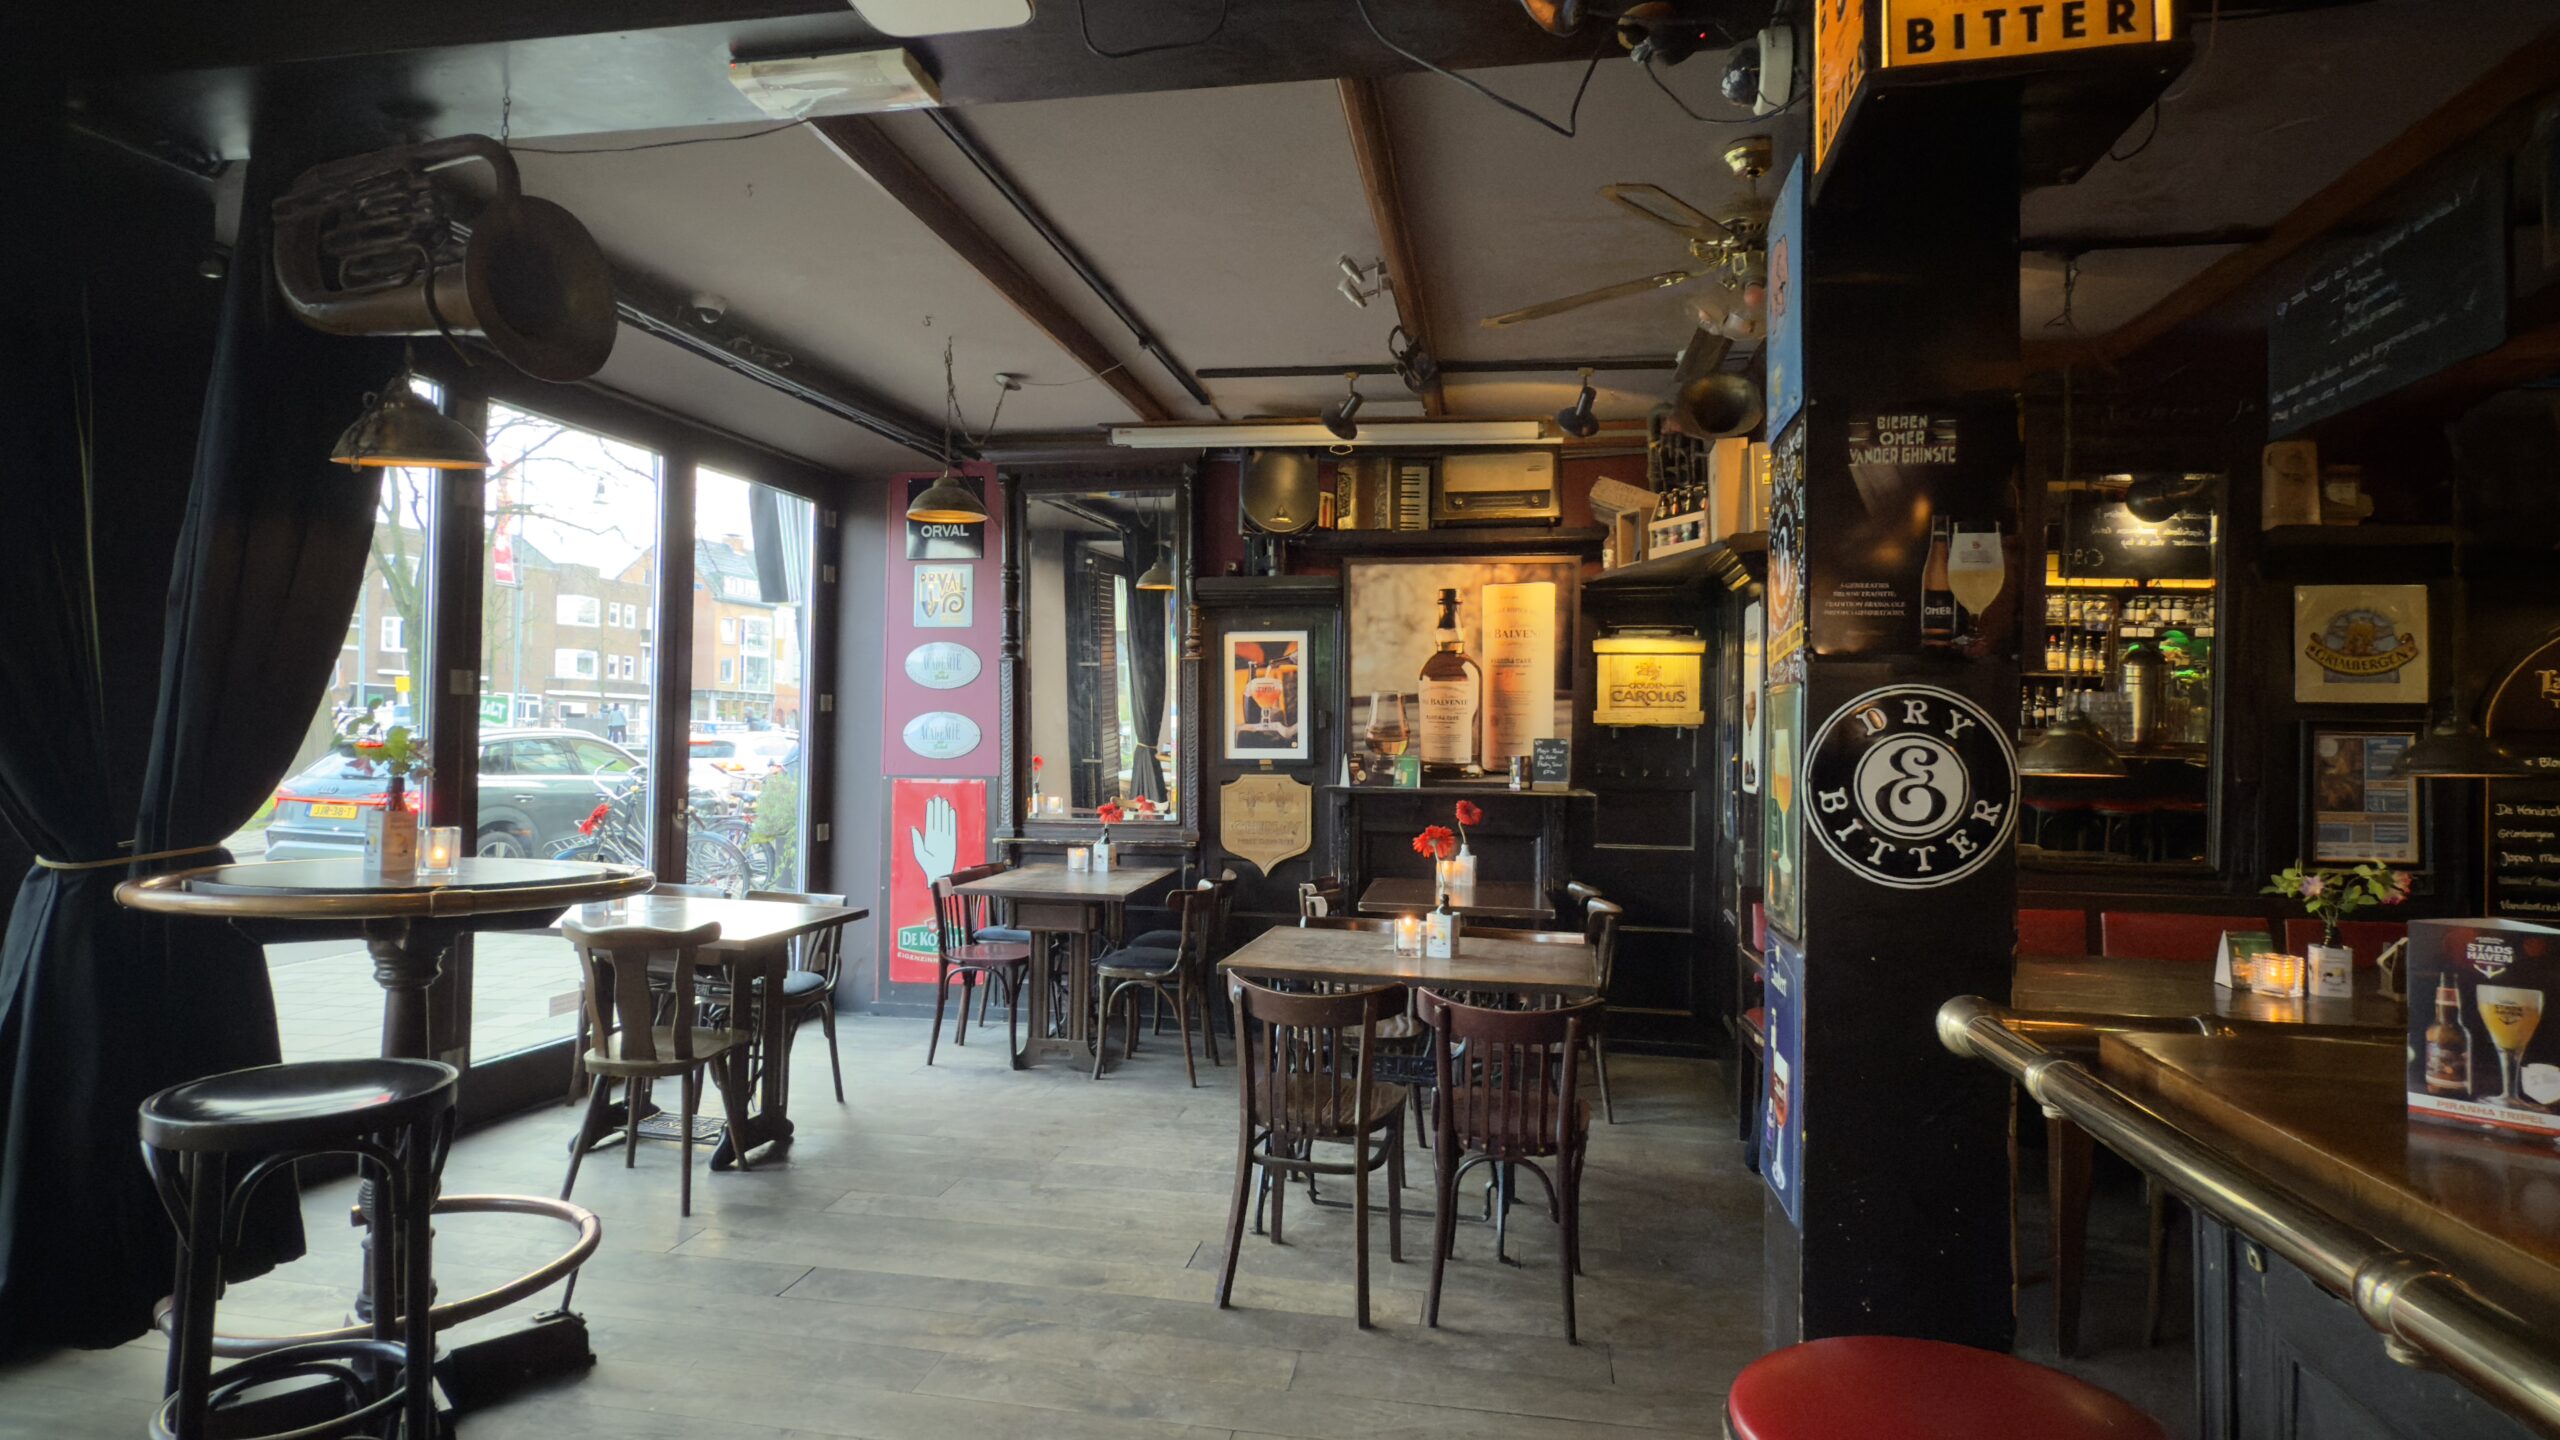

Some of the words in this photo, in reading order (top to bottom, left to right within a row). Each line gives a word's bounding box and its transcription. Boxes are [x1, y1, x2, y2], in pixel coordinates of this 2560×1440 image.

[1906, 0, 2137, 54] BITTER
[1877, 415, 1928, 429] BIEREN
[1879, 431, 1925, 445] OMER
[1849, 447, 1898, 466] VANDER
[1901, 446, 1956, 463] GHINSTE
[921, 524, 969, 537] ORVAL
[2315, 648, 2409, 671] GRIMBERGEN
[1612, 690, 1686, 706] CAROLUS
[1856, 699, 1976, 740] DRY
[2495, 803, 2513, 816] De
[1818, 786, 2003, 872] BITTER
[2466, 943, 2513, 955] STADS
[2466, 951, 2513, 963] HAVEN
[2436, 1100, 2496, 1116] PIRANHA
[2499, 1110, 2546, 1125] TRIPEL
